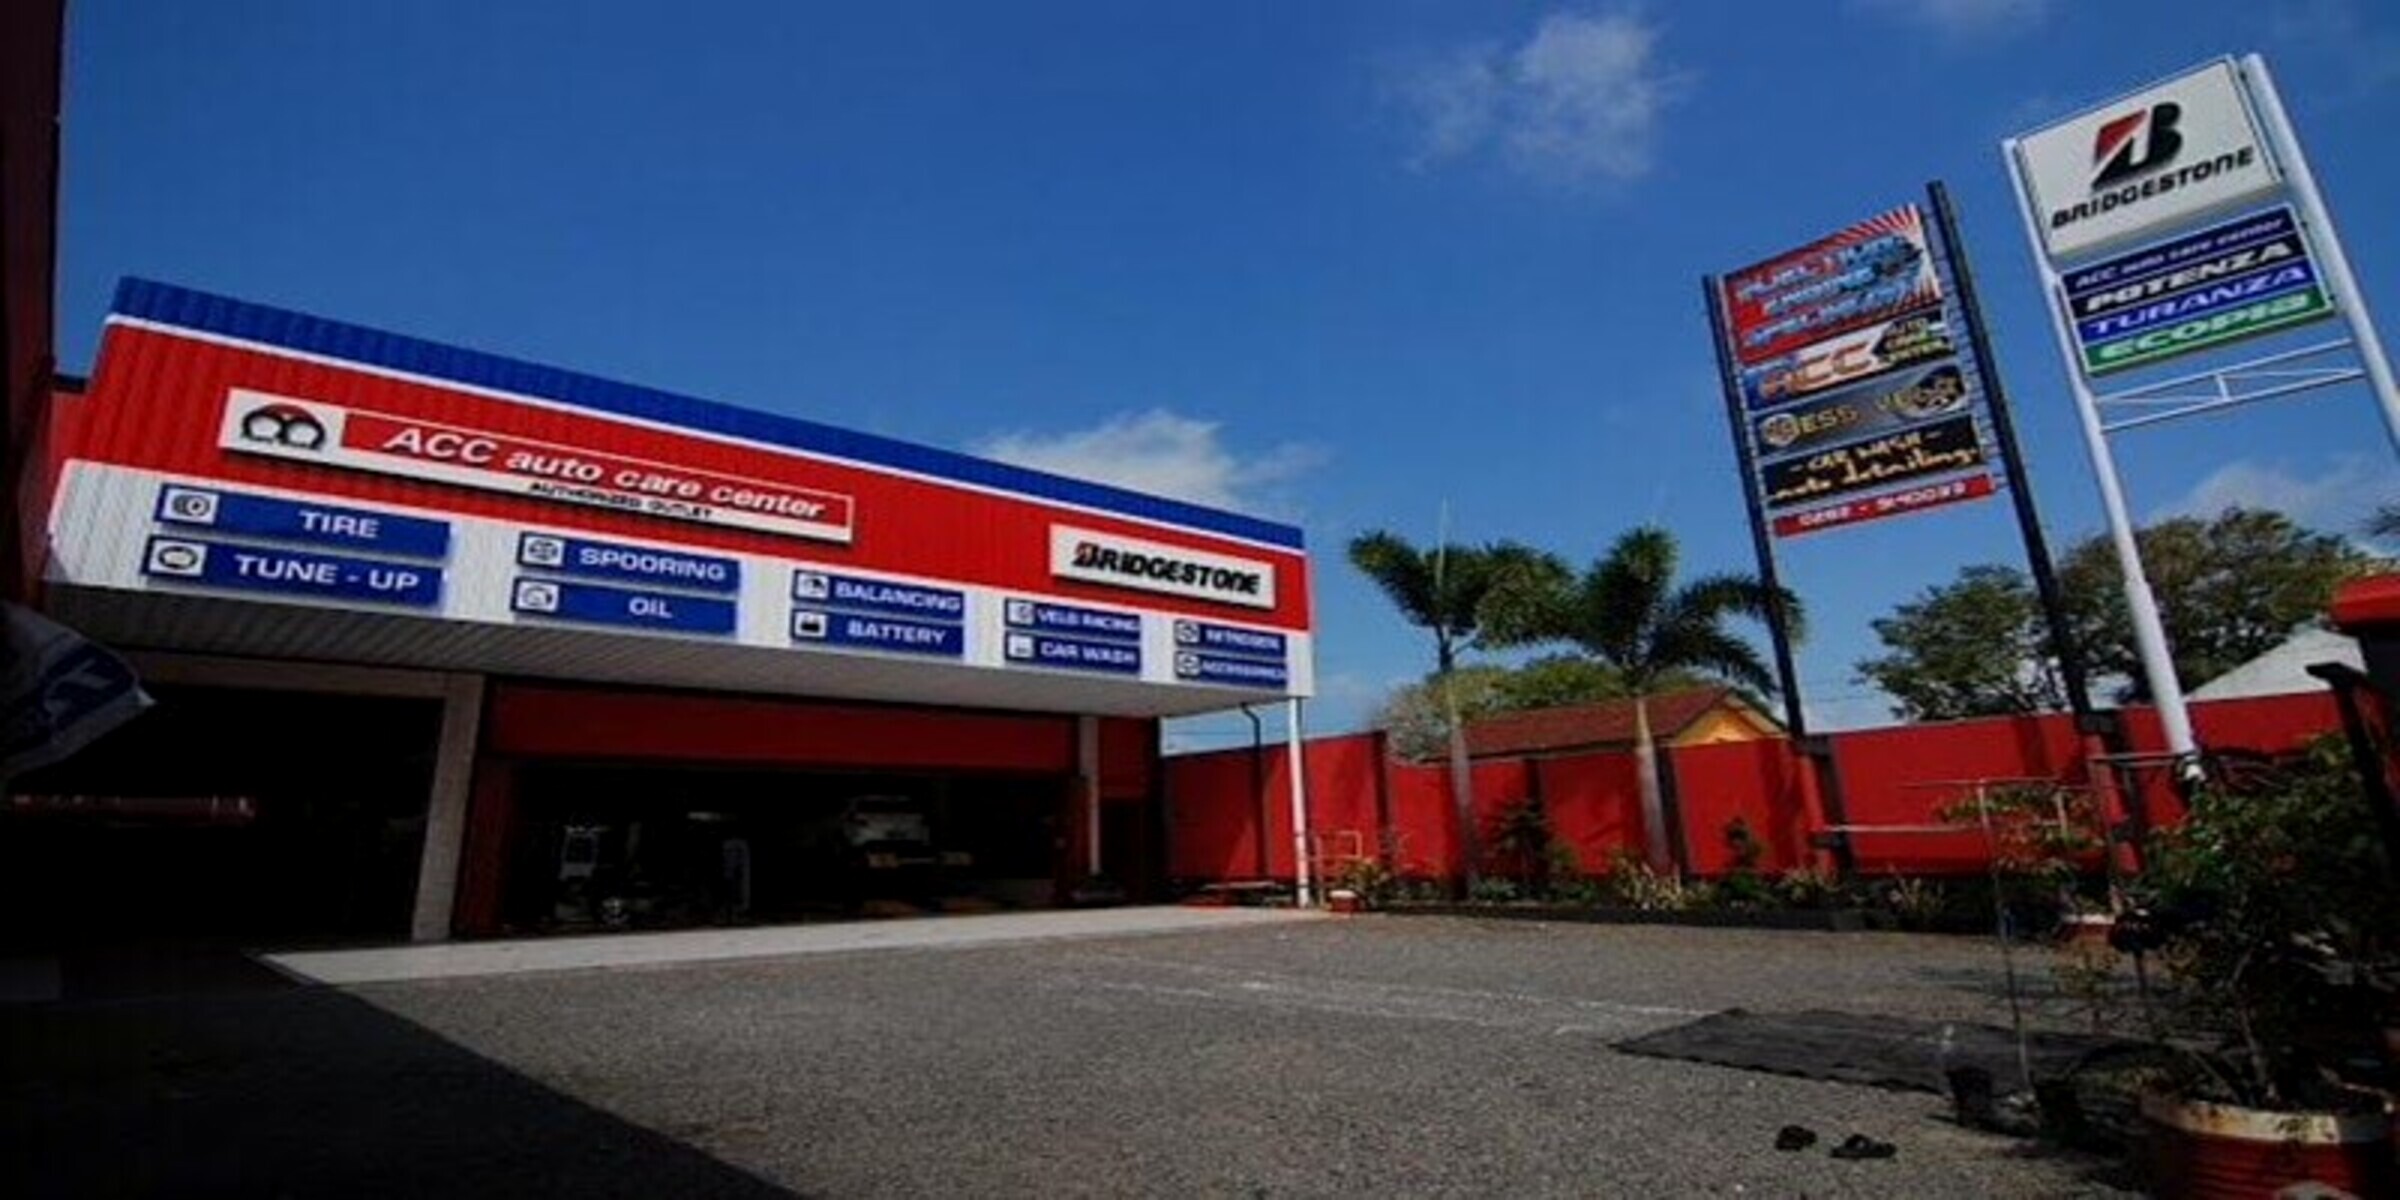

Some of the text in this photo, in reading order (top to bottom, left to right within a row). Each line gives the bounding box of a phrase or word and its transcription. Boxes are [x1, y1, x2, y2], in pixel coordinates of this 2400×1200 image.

[2051, 146, 2255, 230] BRIDGESTONE
[2074, 266, 2120, 289] ACC
[2121, 253, 2165, 276] auto
[2086, 241, 2293, 312] POTENZA
[2087, 268, 2307, 335] TURANZA
[2100, 293, 2309, 358] ECOPIA
[383, 427, 827, 518] ACC auto care center
[299, 509, 381, 540] TIRE
[234, 552, 339, 584] TUNE
[367, 567, 420, 592] UP
[579, 546, 727, 582] SPOORING
[1071, 540, 1262, 596] BRIDGESTONE
[627, 595, 674, 619] OIL
[834, 579, 962, 613] BALANCING
[847, 619, 947, 645] BATTERY
[1040, 640, 1138, 664] CAR WASH
